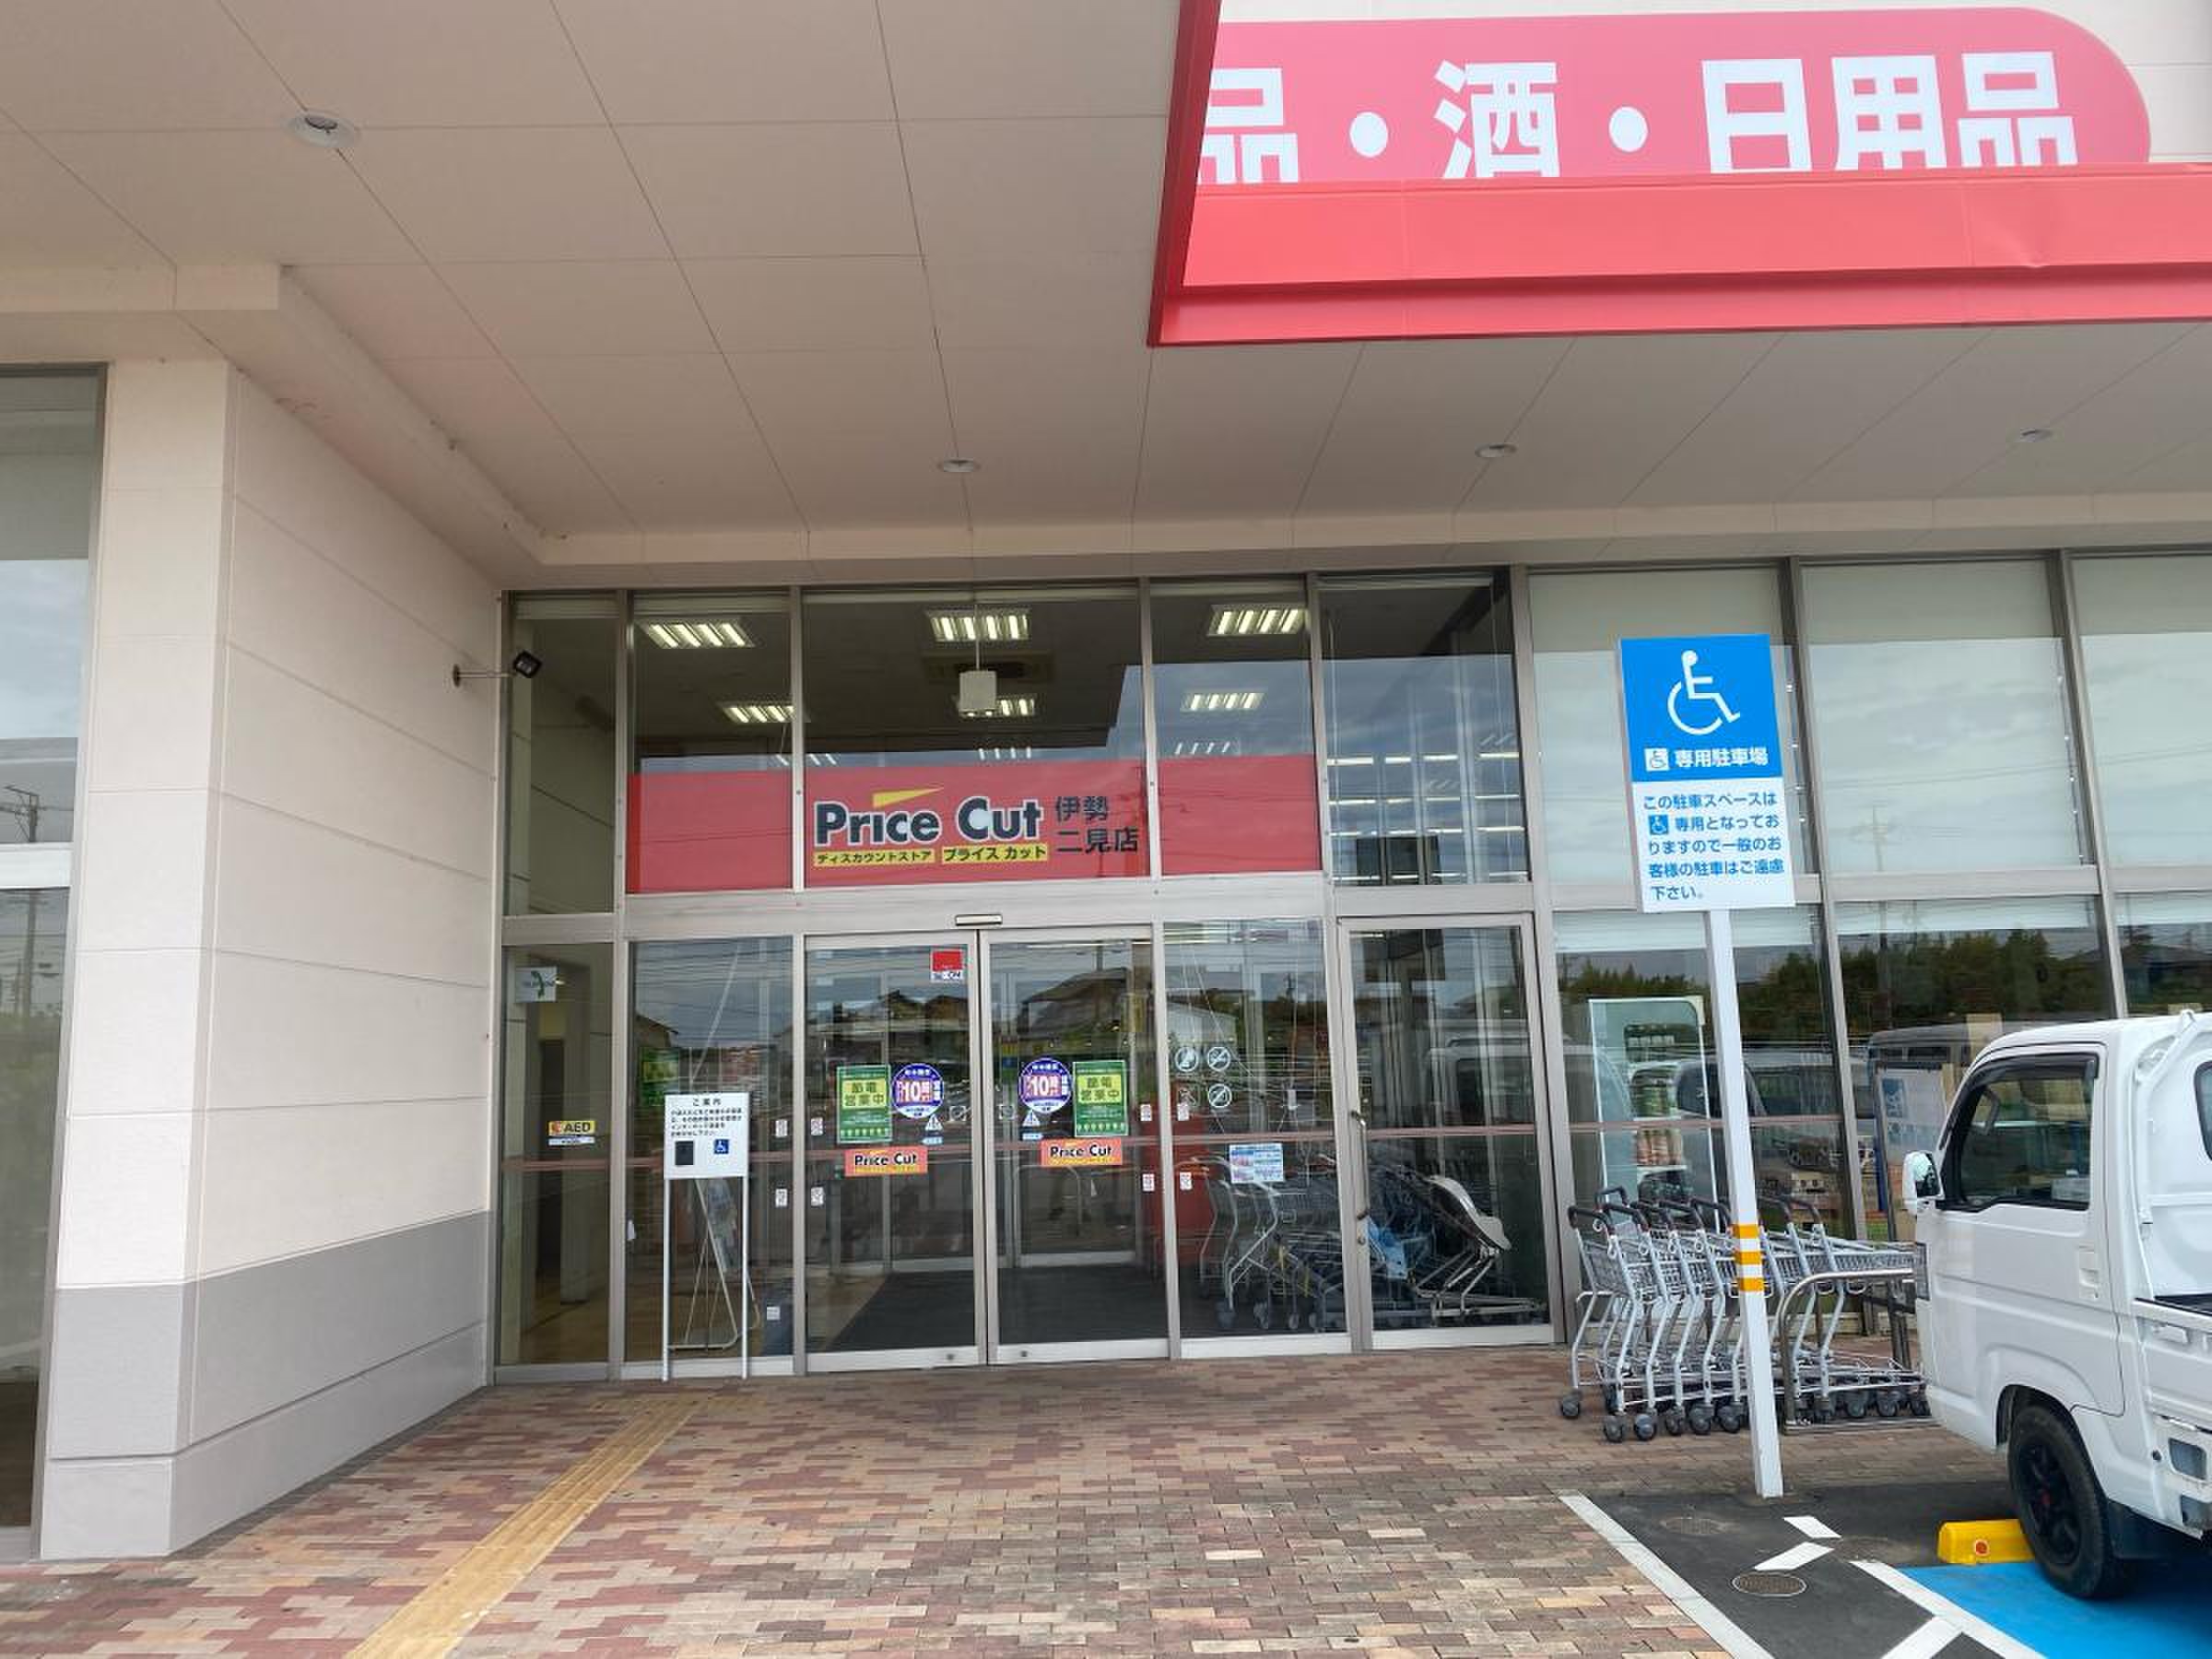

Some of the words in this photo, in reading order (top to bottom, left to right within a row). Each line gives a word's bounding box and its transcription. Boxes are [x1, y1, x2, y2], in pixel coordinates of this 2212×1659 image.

[1675, 747, 1769, 768] 専用駐車場
[1055, 795, 1109, 823] 伊勢
[1643, 793, 1778, 811] この駐車スペースは
[814, 800, 942, 848] Price
[958, 796, 1045, 843] Cut
[1675, 814, 1780, 832] 専用となってお
[1056, 827, 1139, 853] 二見店
[1648, 837, 1783, 856] りますので一般のお
[817, 850, 931, 865] ディスカウントストア
[1648, 858, 1784, 879] 客様の駐車はご遠慮
[563, 1121, 591, 1133] AED
[854, 1154, 889, 1166] Price
[893, 1152, 917, 1165] Cut
[1050, 1145, 1085, 1158] Price
[1088, 1143, 1112, 1157] Cut
